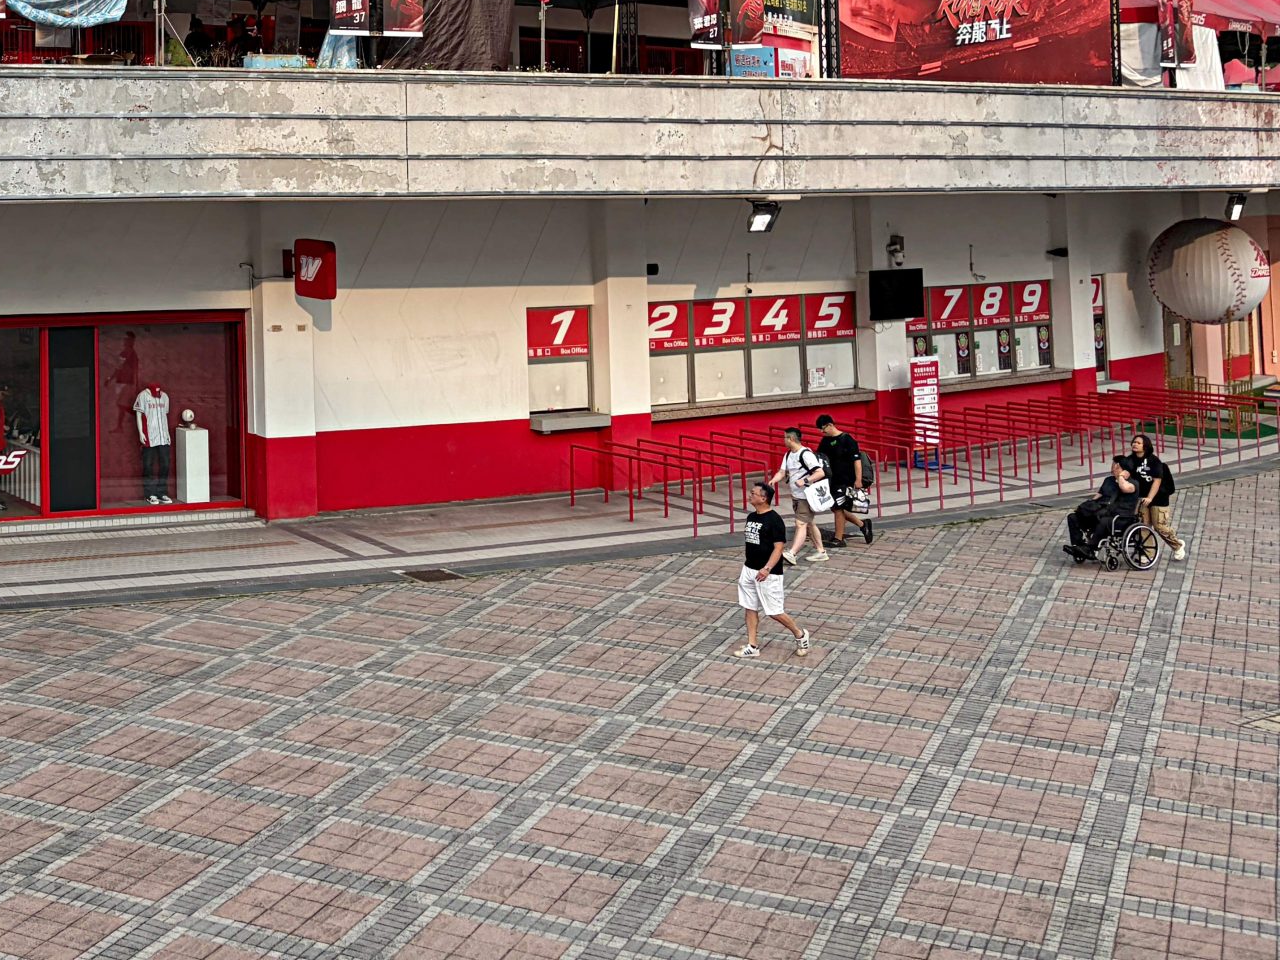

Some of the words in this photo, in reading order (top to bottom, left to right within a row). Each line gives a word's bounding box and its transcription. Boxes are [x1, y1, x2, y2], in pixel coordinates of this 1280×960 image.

[353, 12, 366, 23] 37
[709, 27, 718, 38] 27
[814, 296, 845, 328] 5
[940, 288, 963, 320] 7
[980, 286, 1003, 316] 8
[1021, 283, 1042, 313] 9
[550, 310, 576, 345] 1
[649, 305, 678, 339] 2
[703, 302, 736, 336] 3
[760, 298, 789, 331] 4
